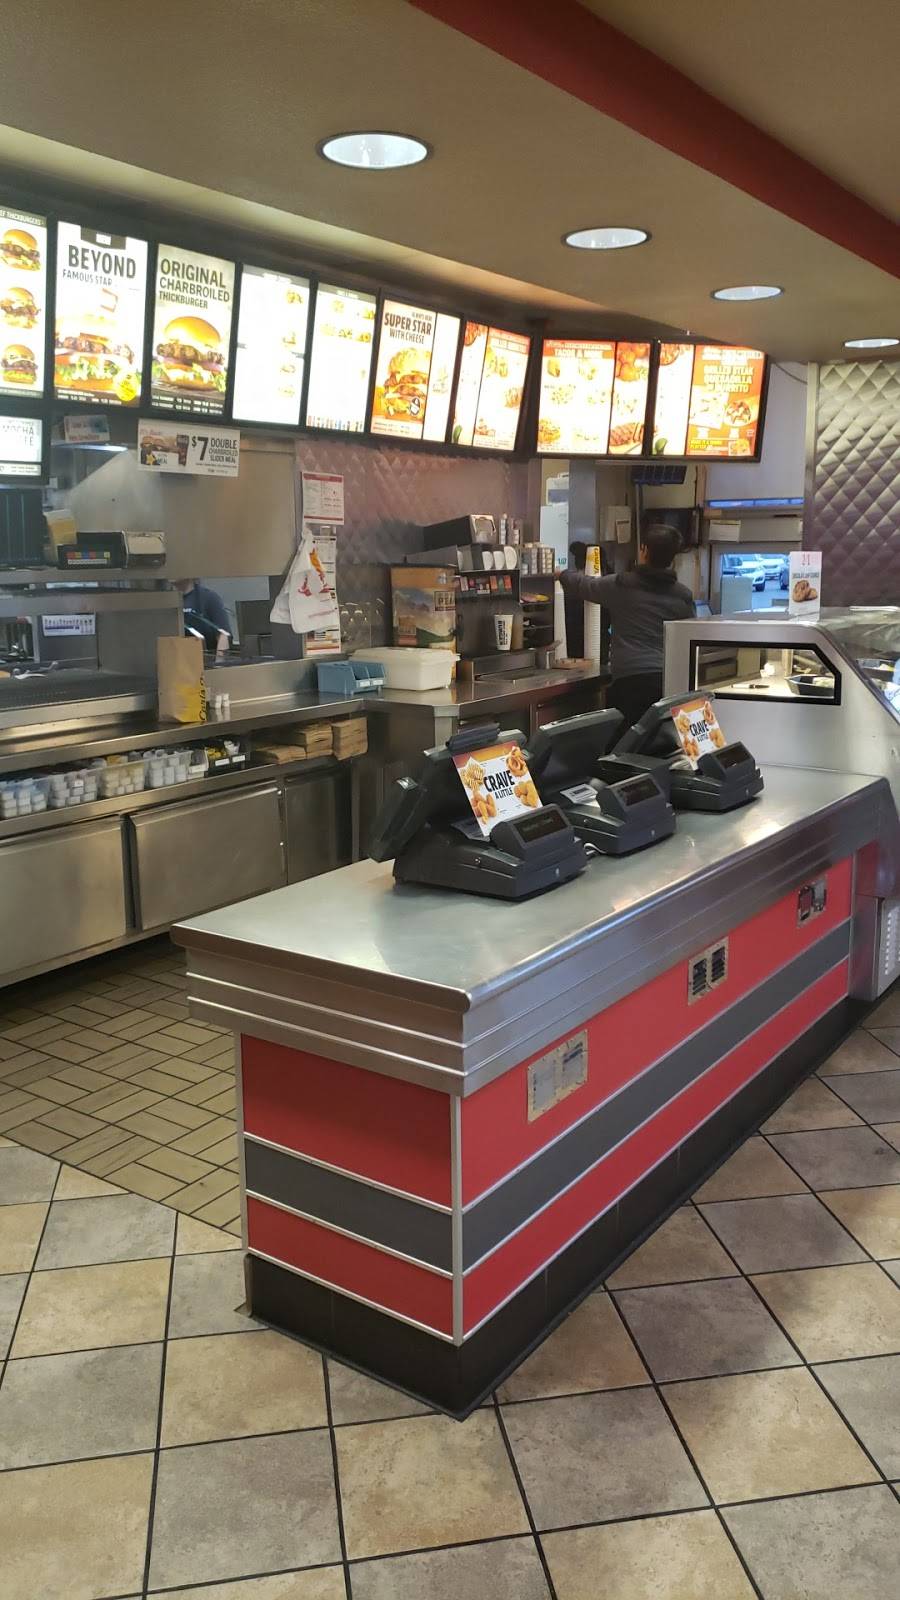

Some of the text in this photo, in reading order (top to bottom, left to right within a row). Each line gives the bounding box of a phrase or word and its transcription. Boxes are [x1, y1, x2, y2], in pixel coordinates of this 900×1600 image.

[68, 244, 136, 278] BEYOND
[62, 268, 94, 283] FAMOUS
[160, 258, 226, 289] ORIGINAL
[158, 290, 208, 309] THICKBURGER
[159, 276, 230, 302] CHARBROILED
[384, 312, 432, 335] SUPER STAR
[389, 328, 425, 344] WITH CHEESE
[191, 436, 208, 461] $7
[210, 438, 237, 450] DOUBLE
[689, 719, 709, 737] CRAVE
[483, 769, 516, 793] CRAVE
[494, 786, 514, 800] A LITTLE
